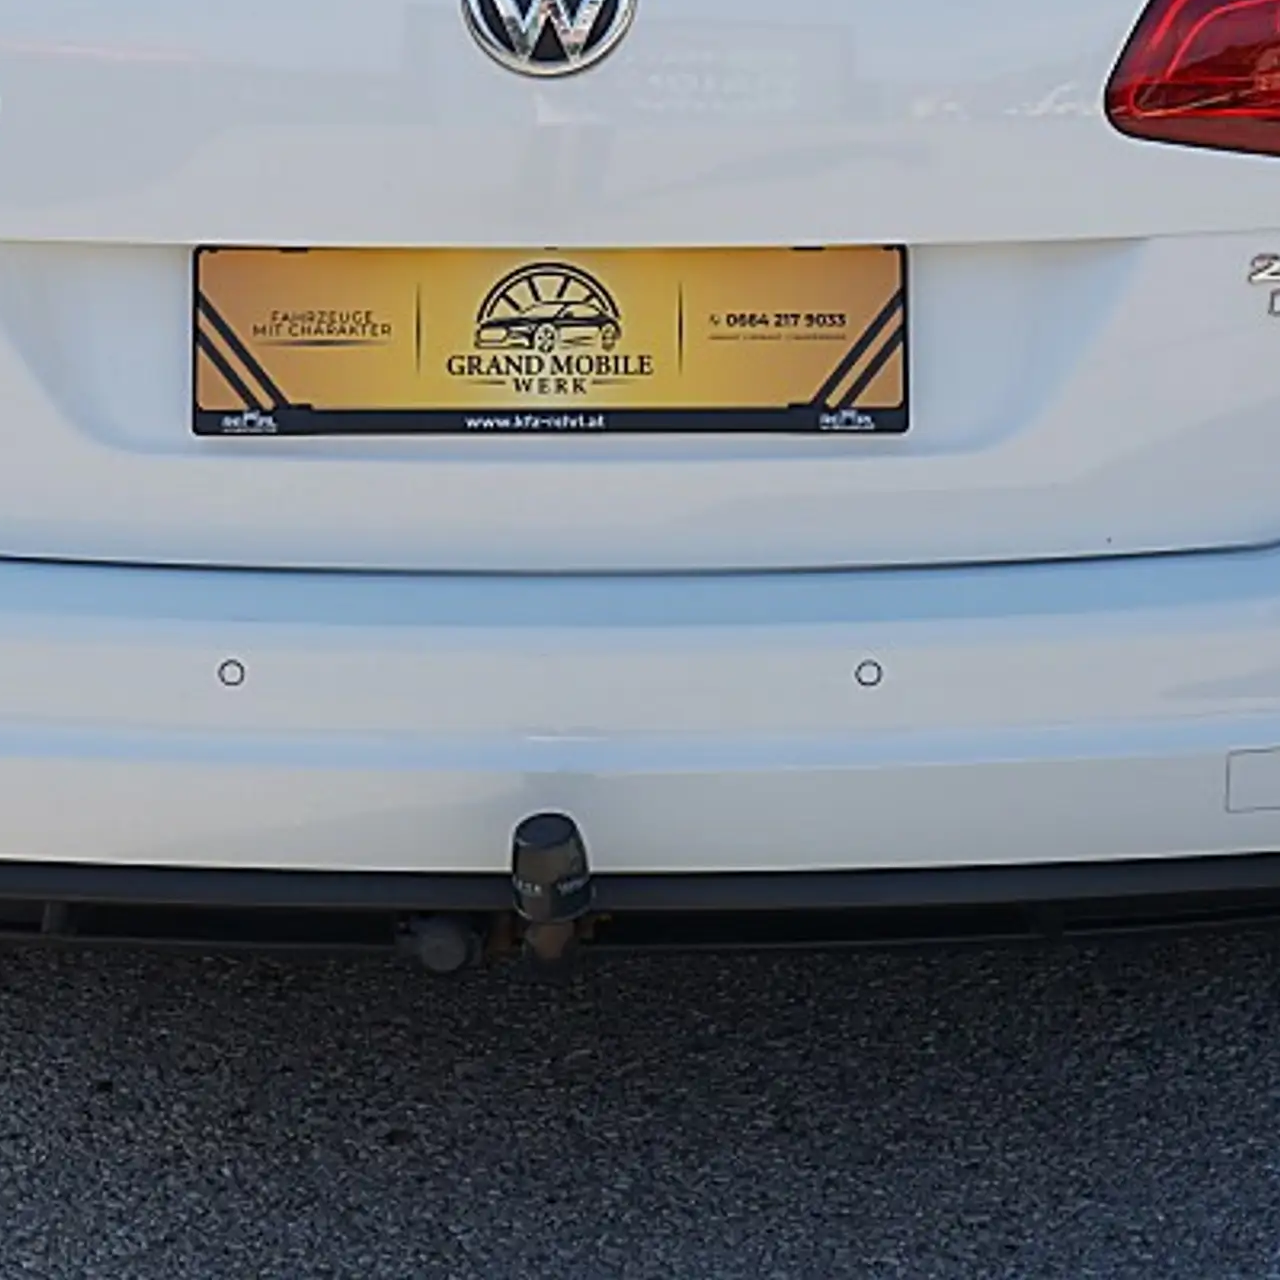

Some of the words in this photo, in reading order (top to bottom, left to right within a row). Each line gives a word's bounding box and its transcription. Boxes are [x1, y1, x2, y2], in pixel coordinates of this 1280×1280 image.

[271, 310, 373, 324] FAHRZEUGE
[726, 313, 770, 327] 0664
[773, 313, 801, 327] 217
[253, 323, 283, 337] MIT
[288, 323, 392, 337] CHARAKTER
[446, 355, 544, 376] GRAND
[550, 355, 654, 376] MOBILE
[513, 378, 588, 395] WERK
